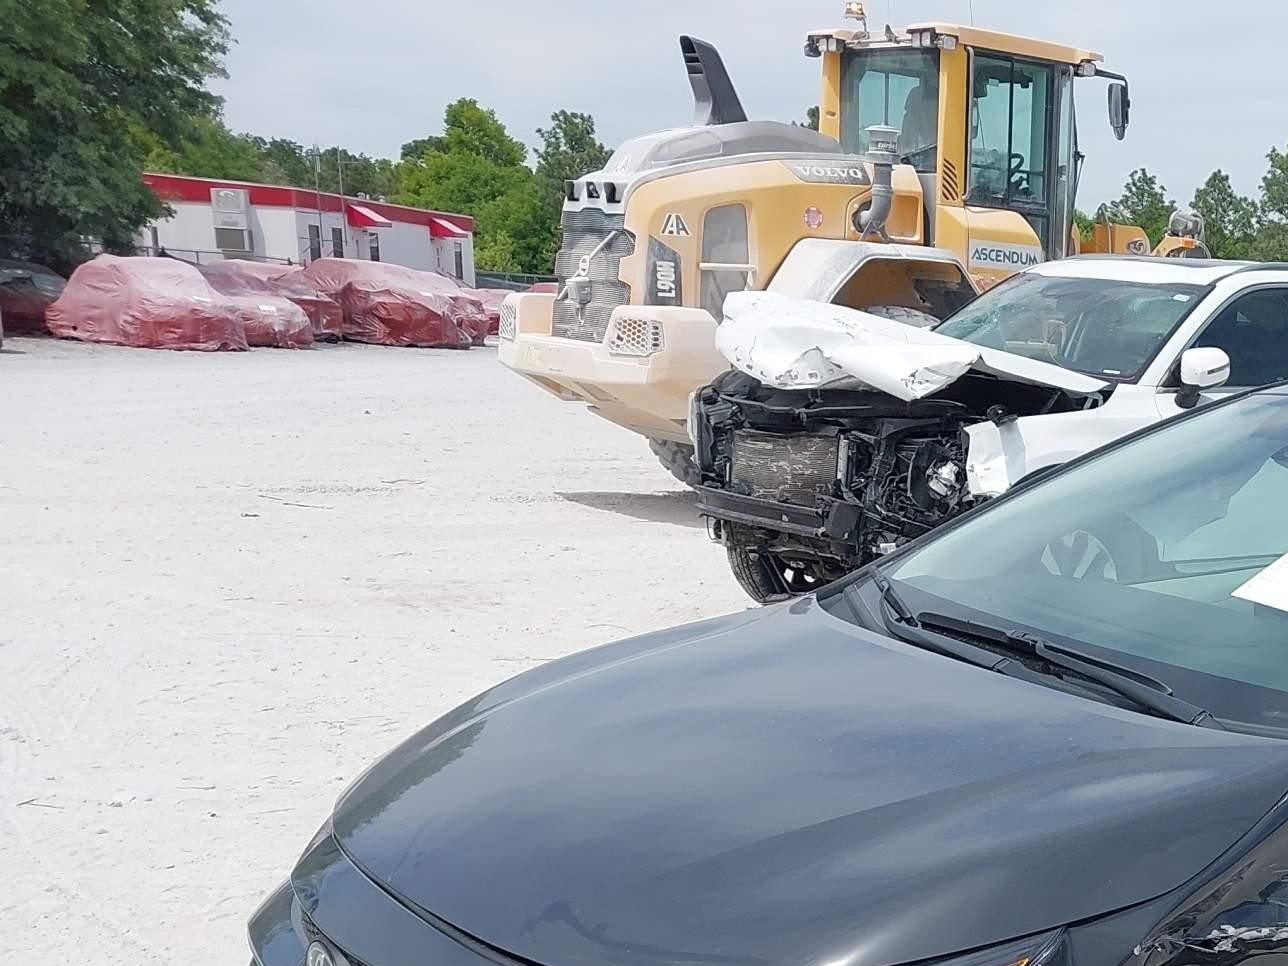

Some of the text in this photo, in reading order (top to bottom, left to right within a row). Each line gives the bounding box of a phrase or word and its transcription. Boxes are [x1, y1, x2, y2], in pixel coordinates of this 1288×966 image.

[794, 166, 863, 179] VOLVO
[971, 247, 1039, 266] ASCENDUM
[656, 261, 677, 297] L90H
